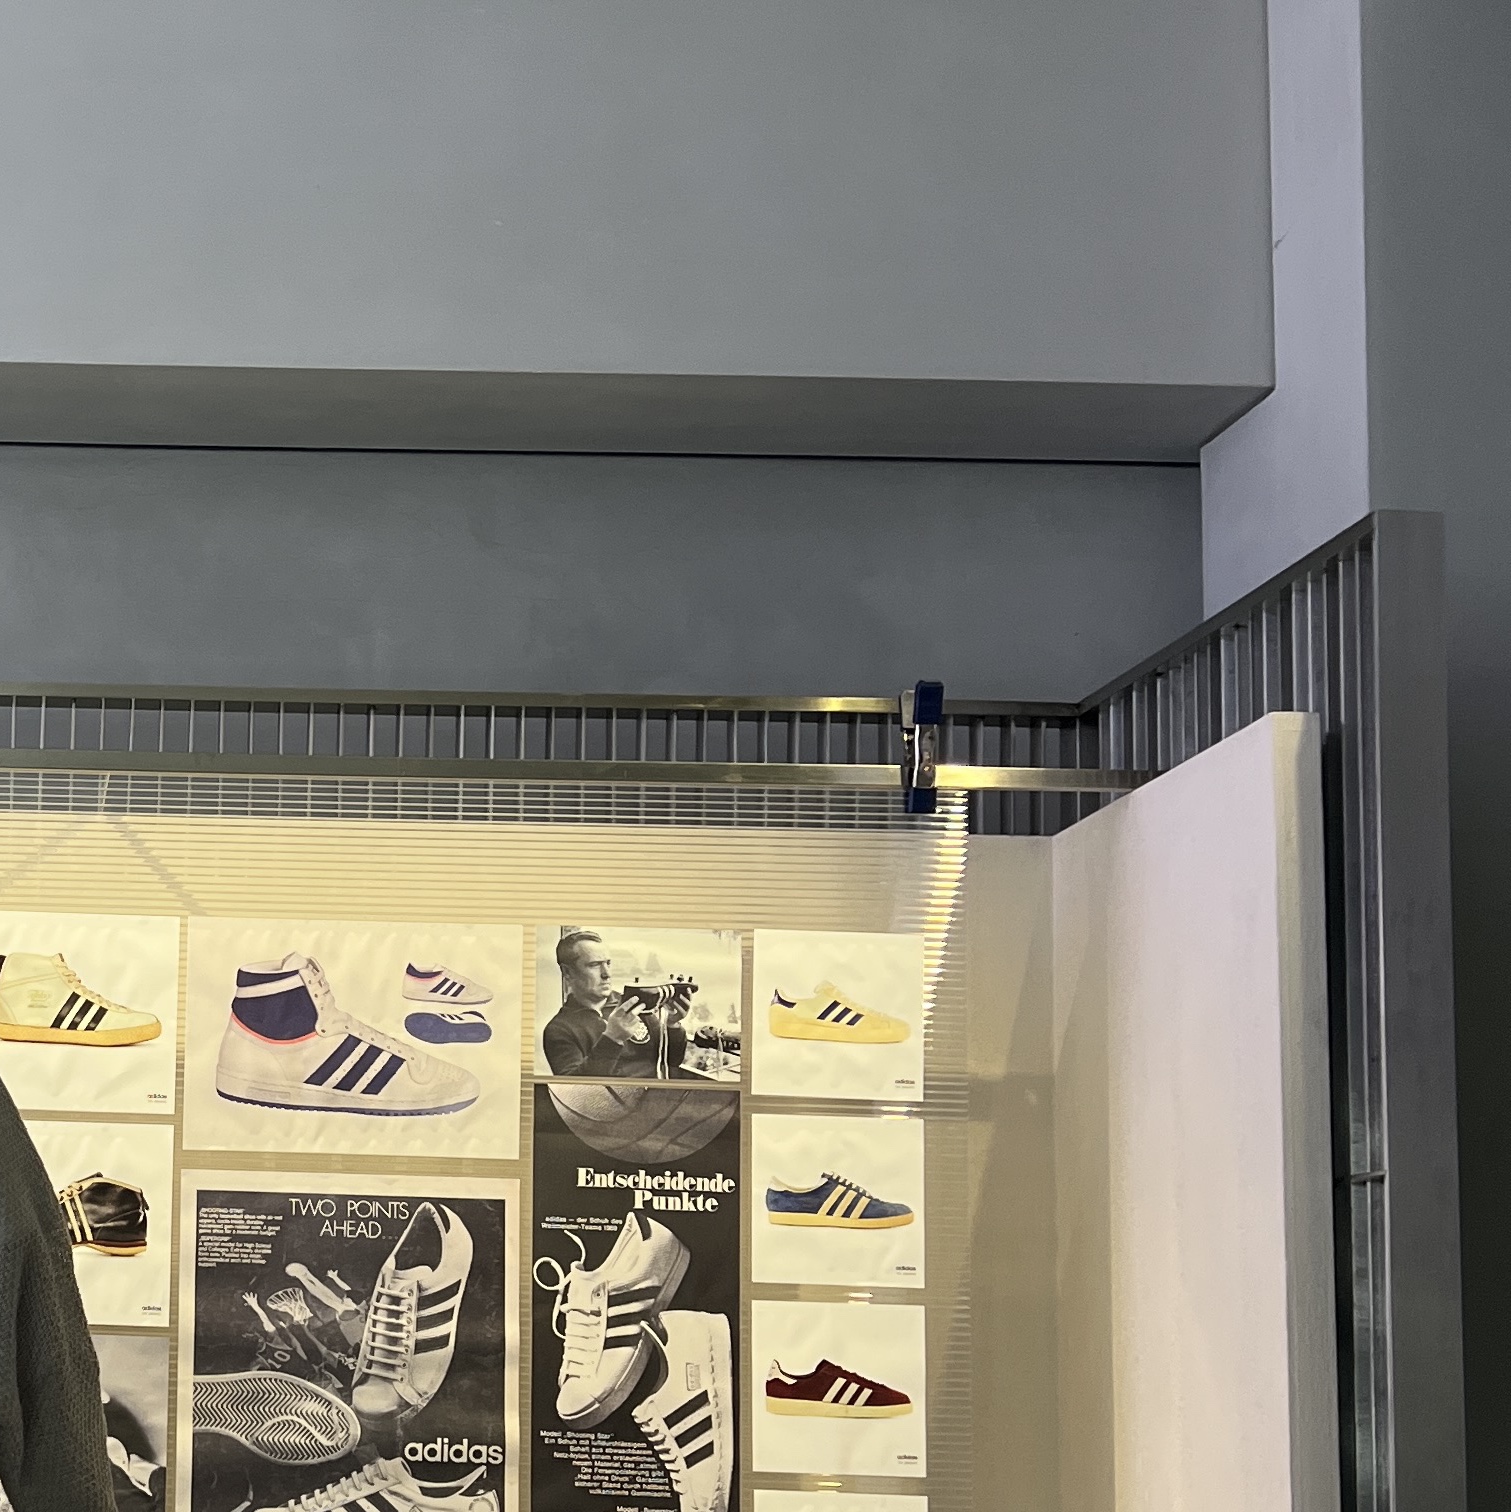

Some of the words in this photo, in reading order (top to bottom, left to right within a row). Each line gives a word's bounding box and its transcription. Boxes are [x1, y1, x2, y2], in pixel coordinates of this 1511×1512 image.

[576, 1167, 736, 1194] Entscheidende
[288, 1198, 337, 1218] TWO
[347, 1199, 410, 1220] POINTS
[633, 1189, 719, 1213] Punkte
[404, 1437, 504, 1465] adidas
